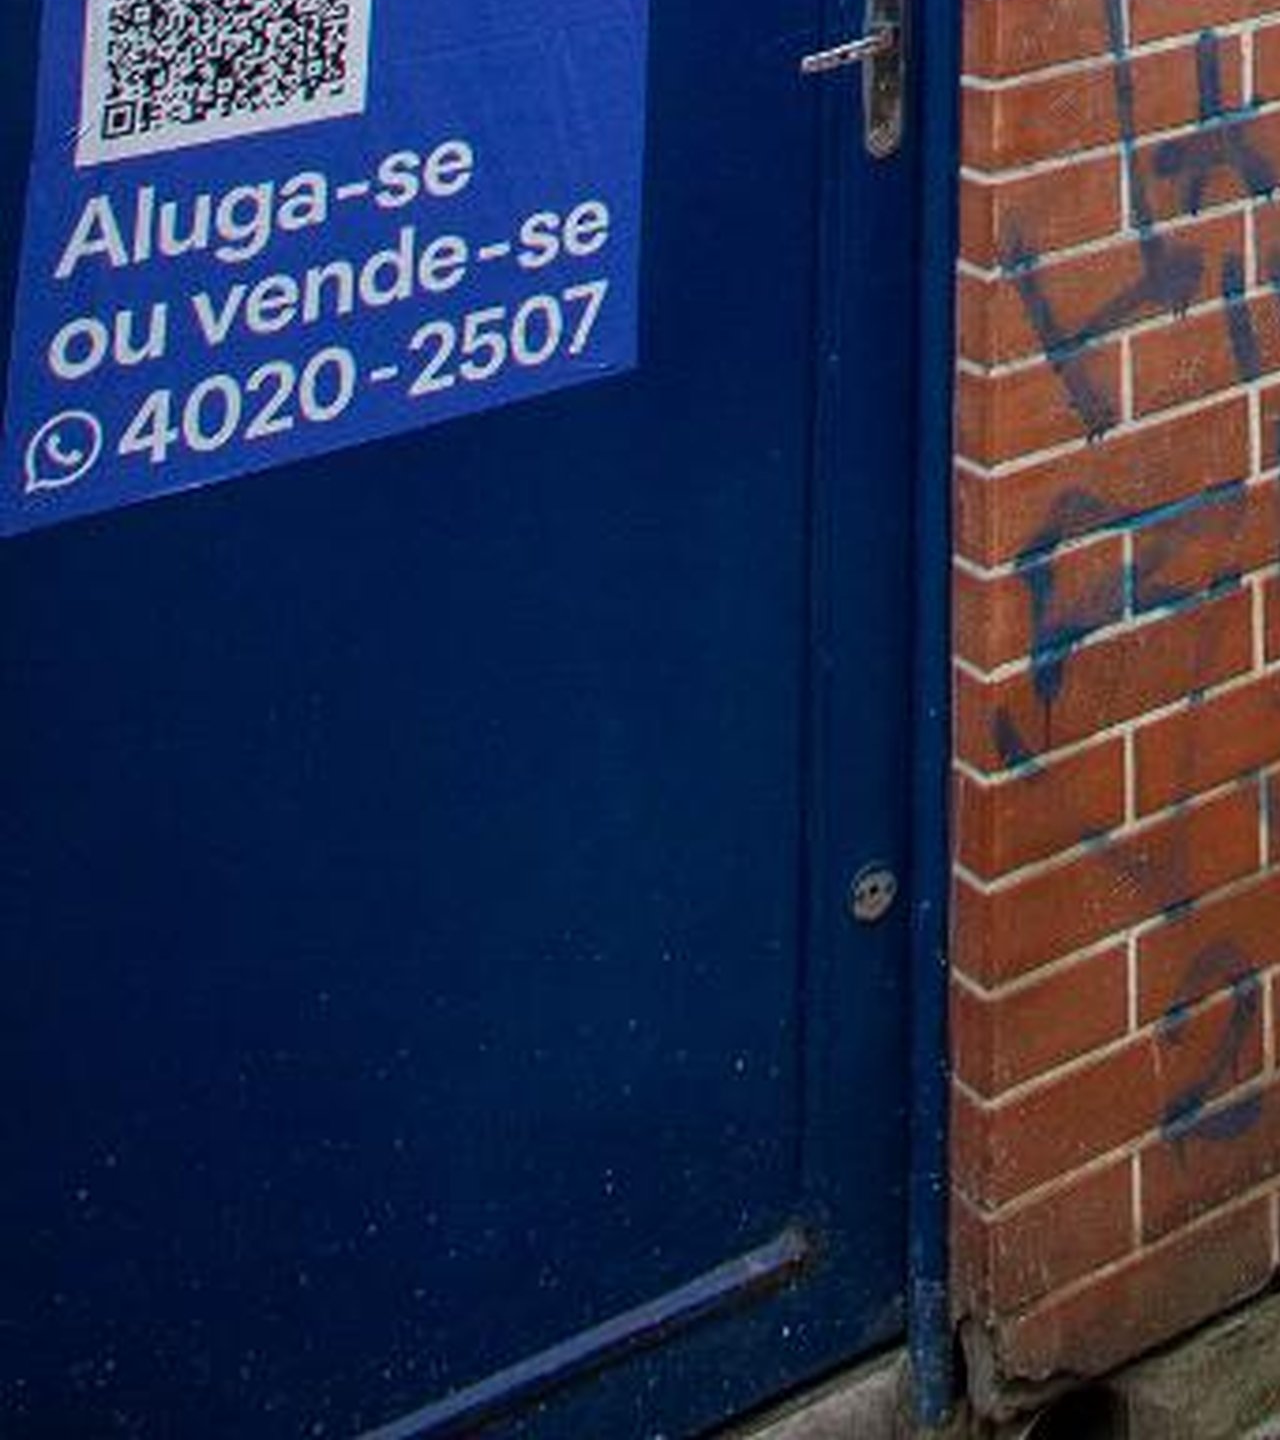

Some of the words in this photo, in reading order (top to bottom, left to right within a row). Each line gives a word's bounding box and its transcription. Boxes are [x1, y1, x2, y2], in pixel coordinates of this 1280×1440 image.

[47, 291, 169, 382] ou
[190, 196, 611, 347] vende-se
[53, 137, 476, 280] Aluga-se
[117, 281, 611, 466] 4020-2507
